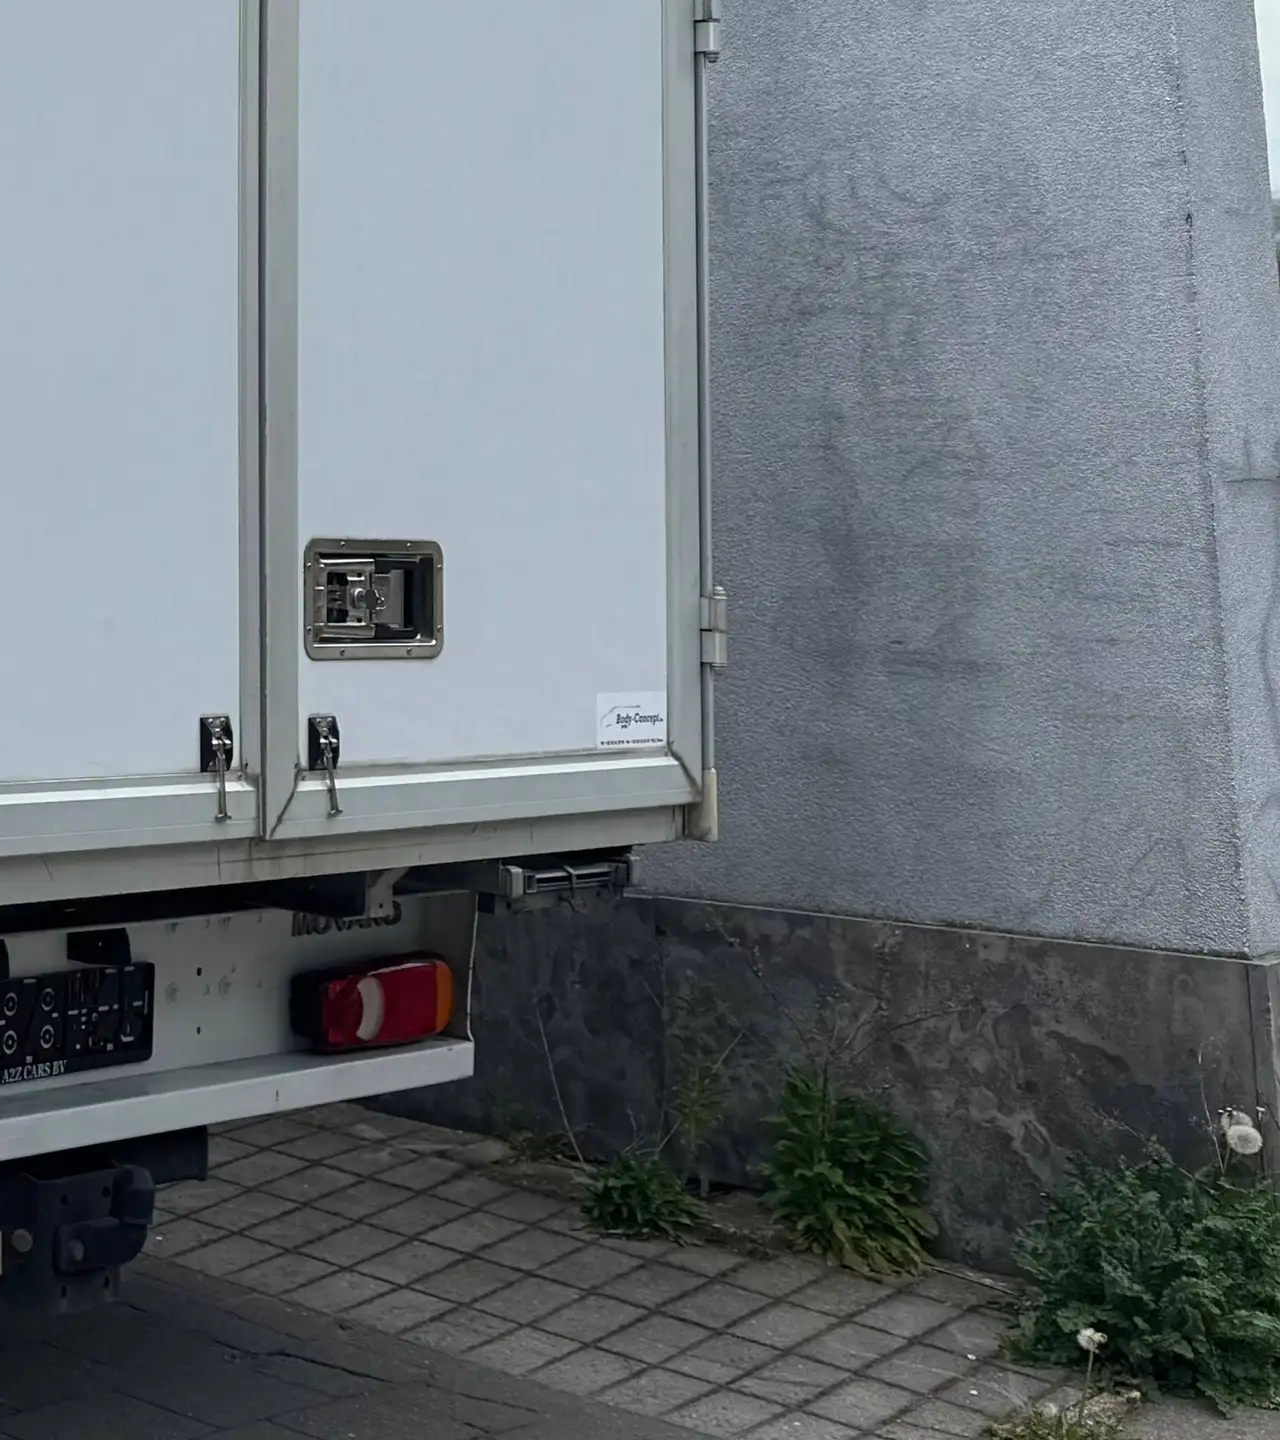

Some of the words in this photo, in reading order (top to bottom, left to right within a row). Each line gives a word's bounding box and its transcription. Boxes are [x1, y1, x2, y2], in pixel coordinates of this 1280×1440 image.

[1, 1066, 23, 1084] A2Z
[23, 1062, 51, 1080] CARS
[52, 1059, 68, 1076] BV
